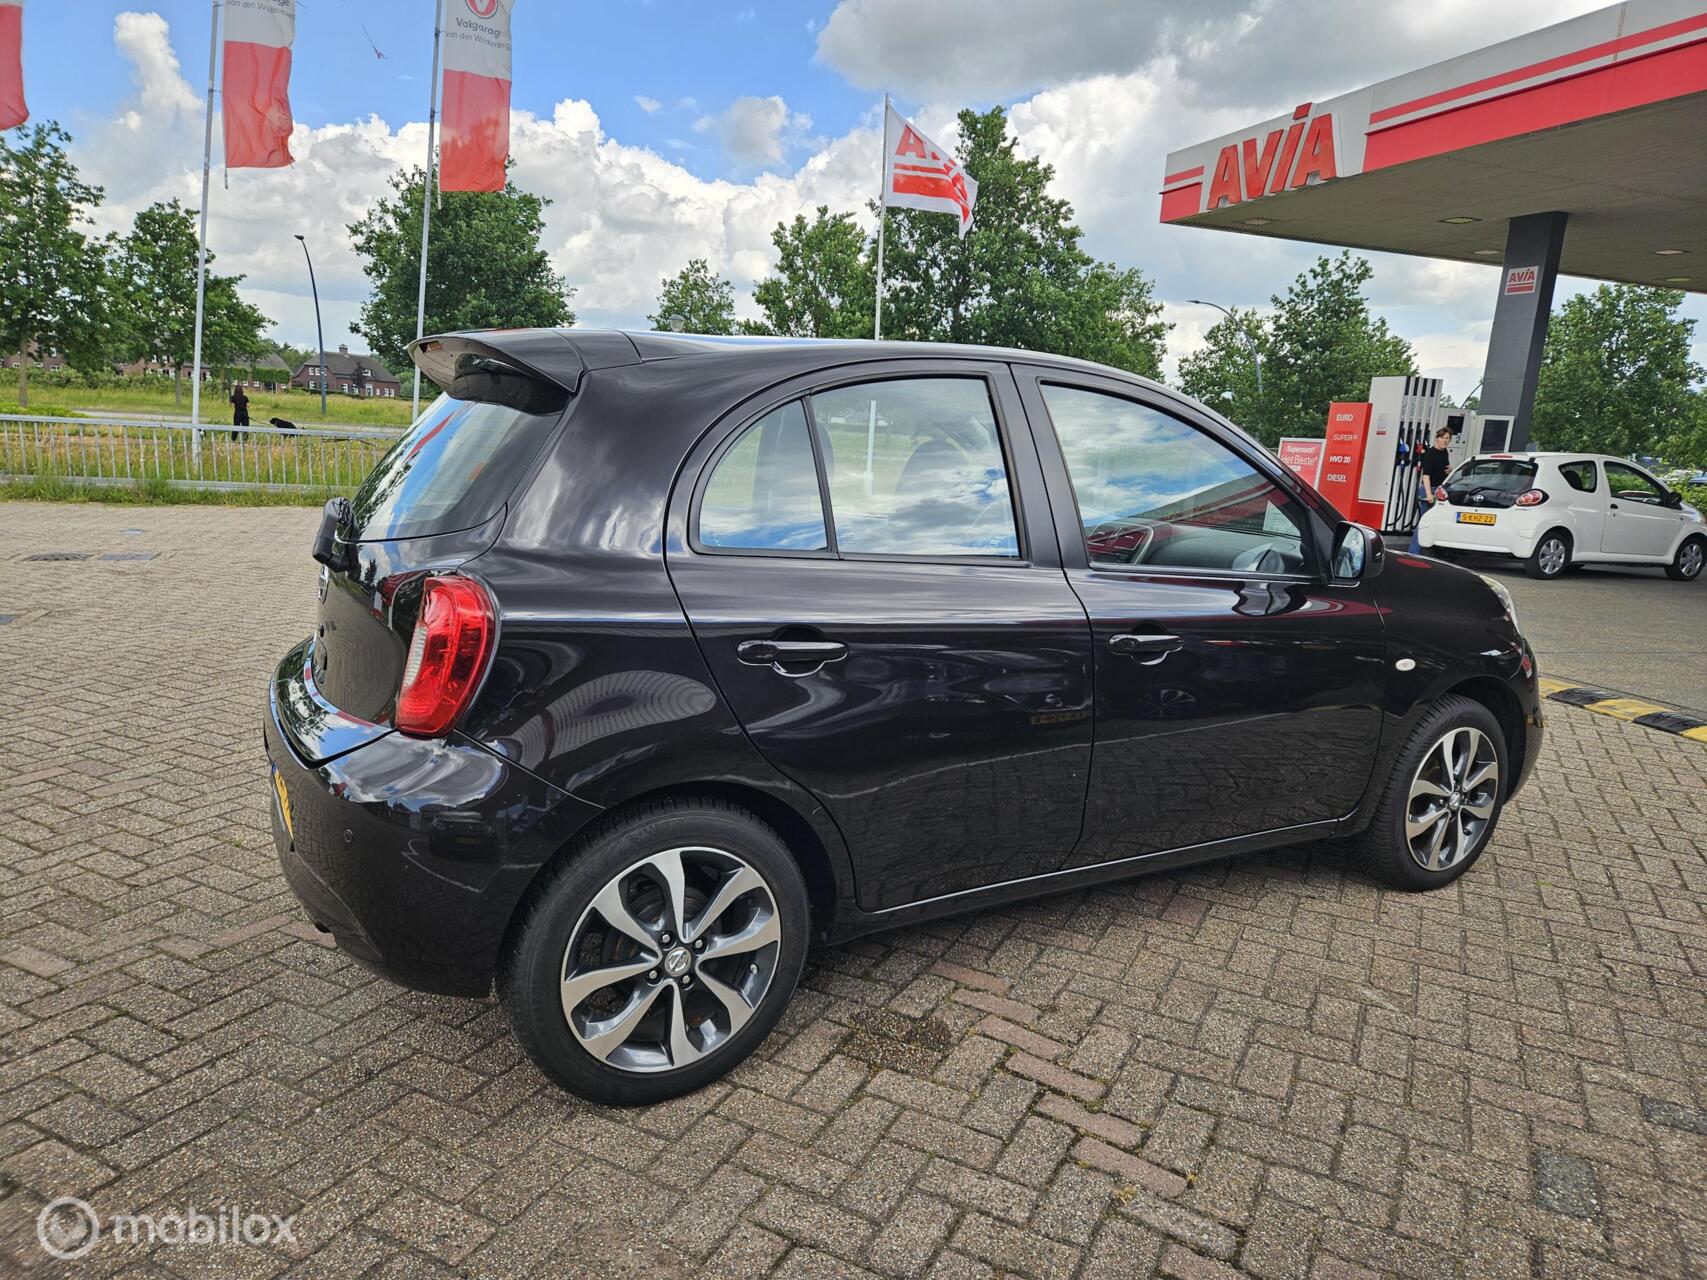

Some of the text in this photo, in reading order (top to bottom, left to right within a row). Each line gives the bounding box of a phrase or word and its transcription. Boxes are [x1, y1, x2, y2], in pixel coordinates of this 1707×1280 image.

[456, 17, 502, 39] Vakgarag
[1336, 414, 1354, 422] EURO
[1327, 473, 1347, 482] DIESEL
